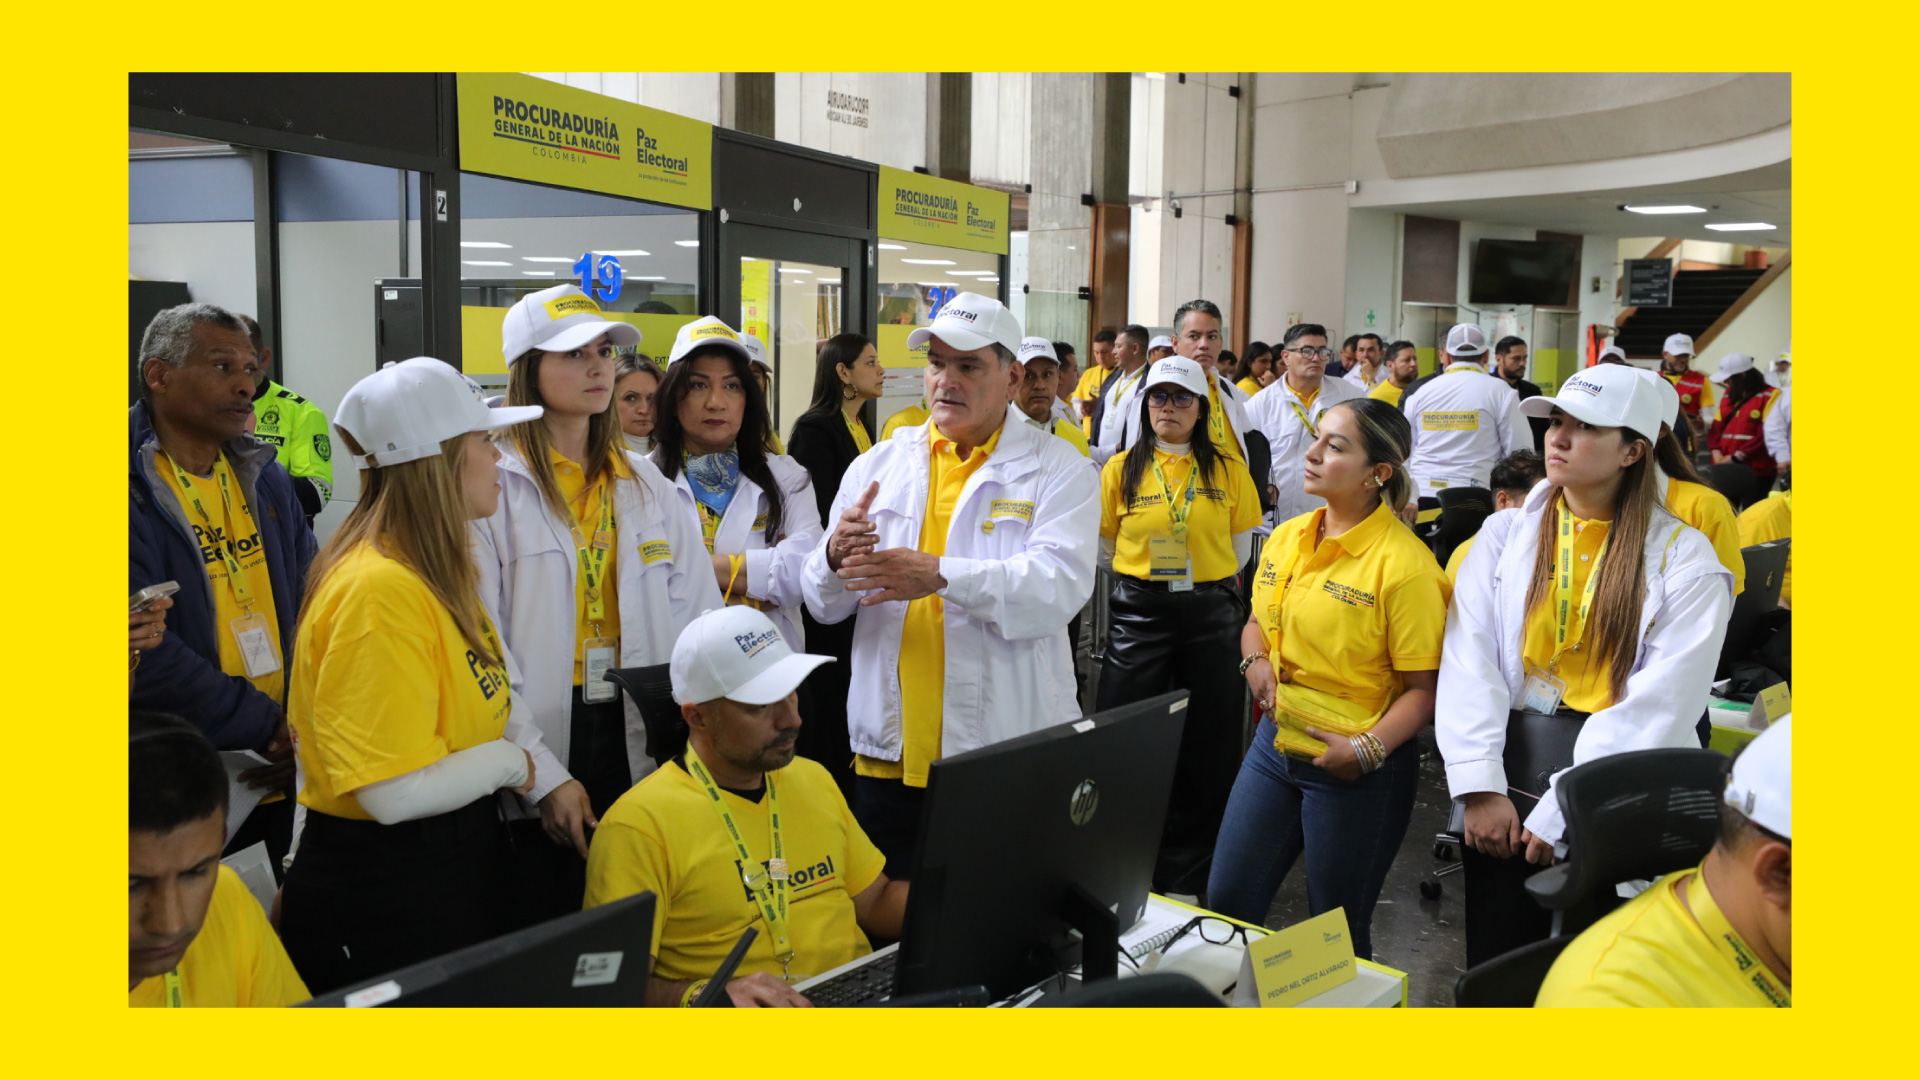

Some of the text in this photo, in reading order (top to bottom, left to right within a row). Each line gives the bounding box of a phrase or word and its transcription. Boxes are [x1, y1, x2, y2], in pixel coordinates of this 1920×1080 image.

[493, 95, 620, 141] PROCURADURÍA
[494, 118, 620, 155] GENERAL DE LA NACIÓN
[636, 127, 658, 150] Paz
[532, 146, 588, 165] COLOMBIA
[636, 148, 688, 173] Electoral
[437, 195, 446, 215] 2
[895, 187, 958, 212] PROCURADURÍA
[967, 201, 979, 216] Paz
[895, 203, 958, 221] GENERAL DE LA NACIÓN
[966, 215, 996, 230] Electoral
[572, 253, 622, 302] 19
[1325, 579, 1375, 601] PROCURADURÍA
[734, 631, 756, 646] Paz
[1267, 959, 1349, 999] PEDRO NEL ORTIZ ALVARADO
